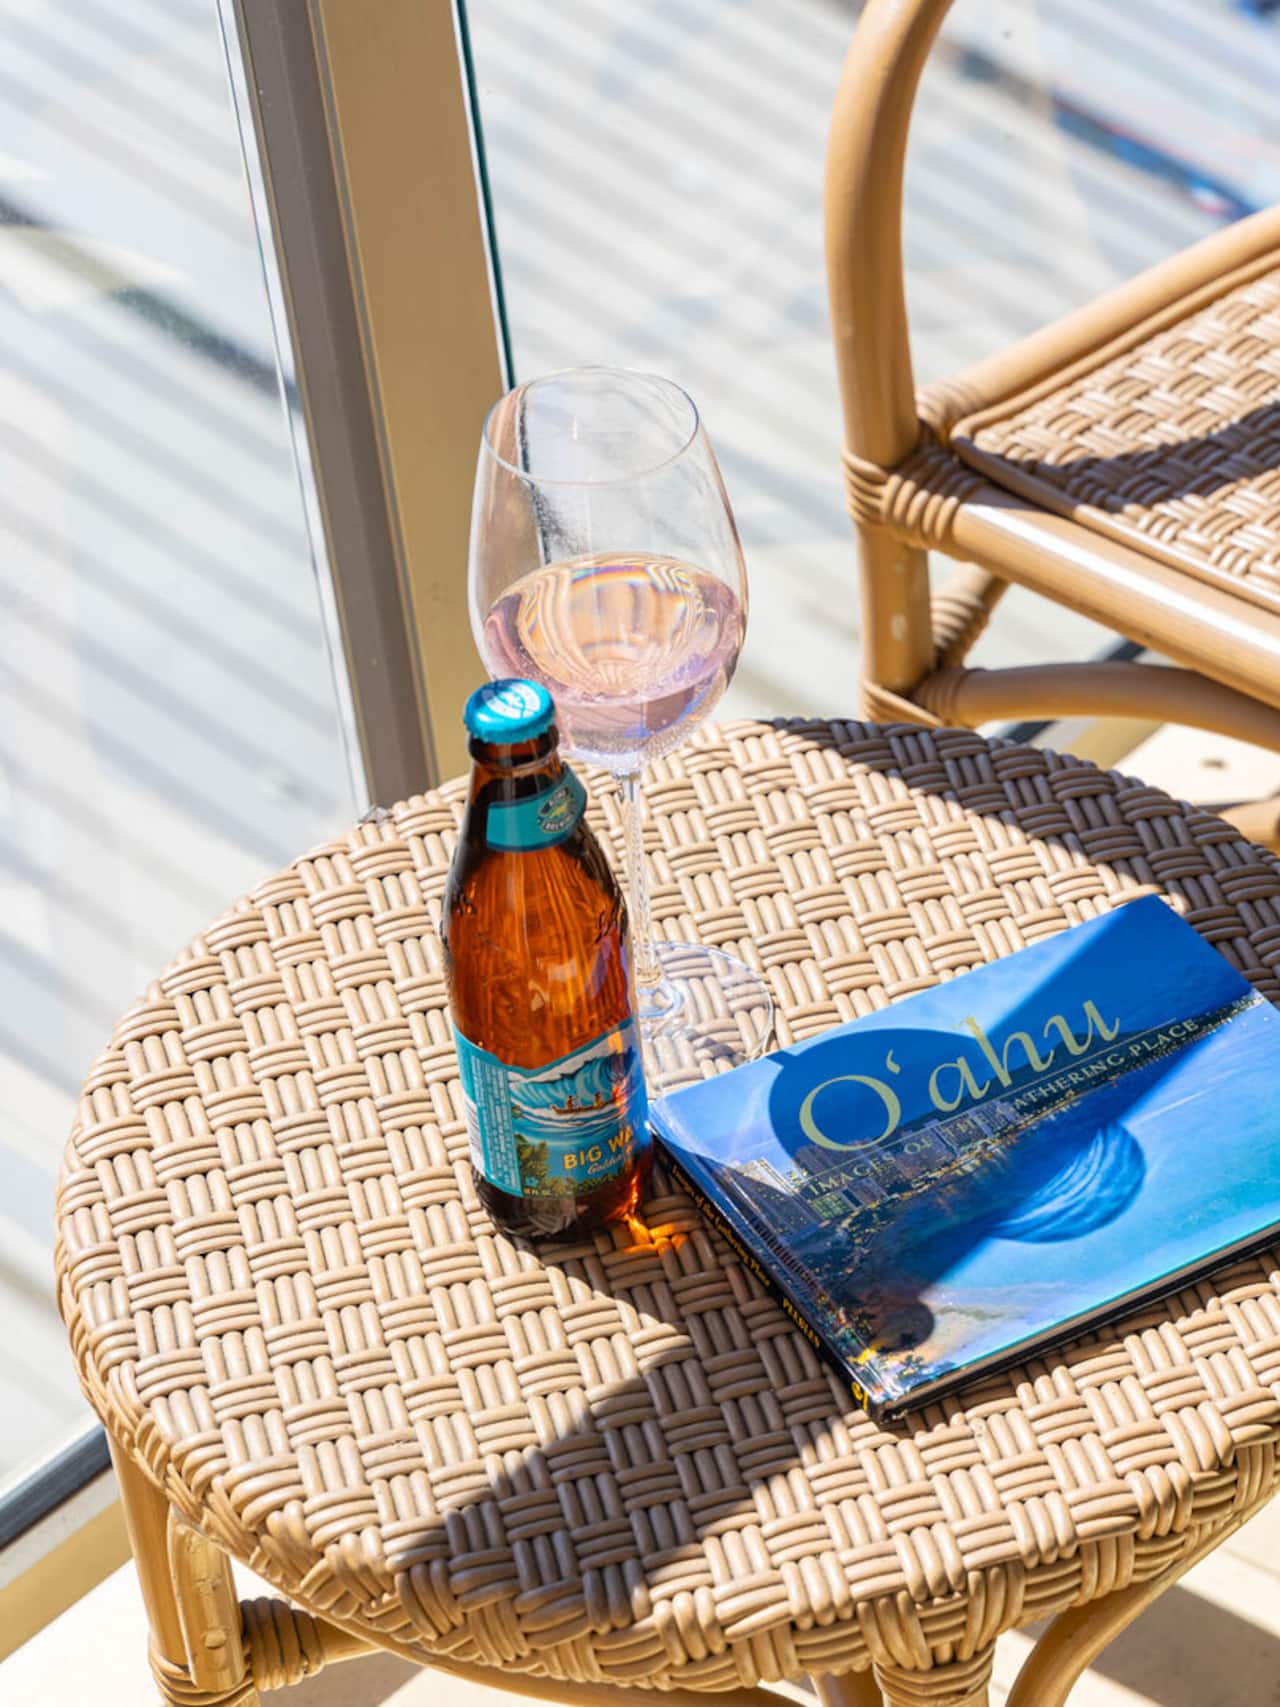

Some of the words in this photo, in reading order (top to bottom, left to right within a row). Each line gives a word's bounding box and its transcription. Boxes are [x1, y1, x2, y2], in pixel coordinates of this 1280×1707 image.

[563, 1145, 602, 1169] BIG
[608, 1124, 634, 1153] WA
[799, 999, 1120, 1151] O'ahu
[809, 1152, 896, 1196] IMAGES
[903, 1134, 935, 1156] OF
[943, 1112, 988, 1138] THE
[1129, 1018, 1200, 1057] PLACE
